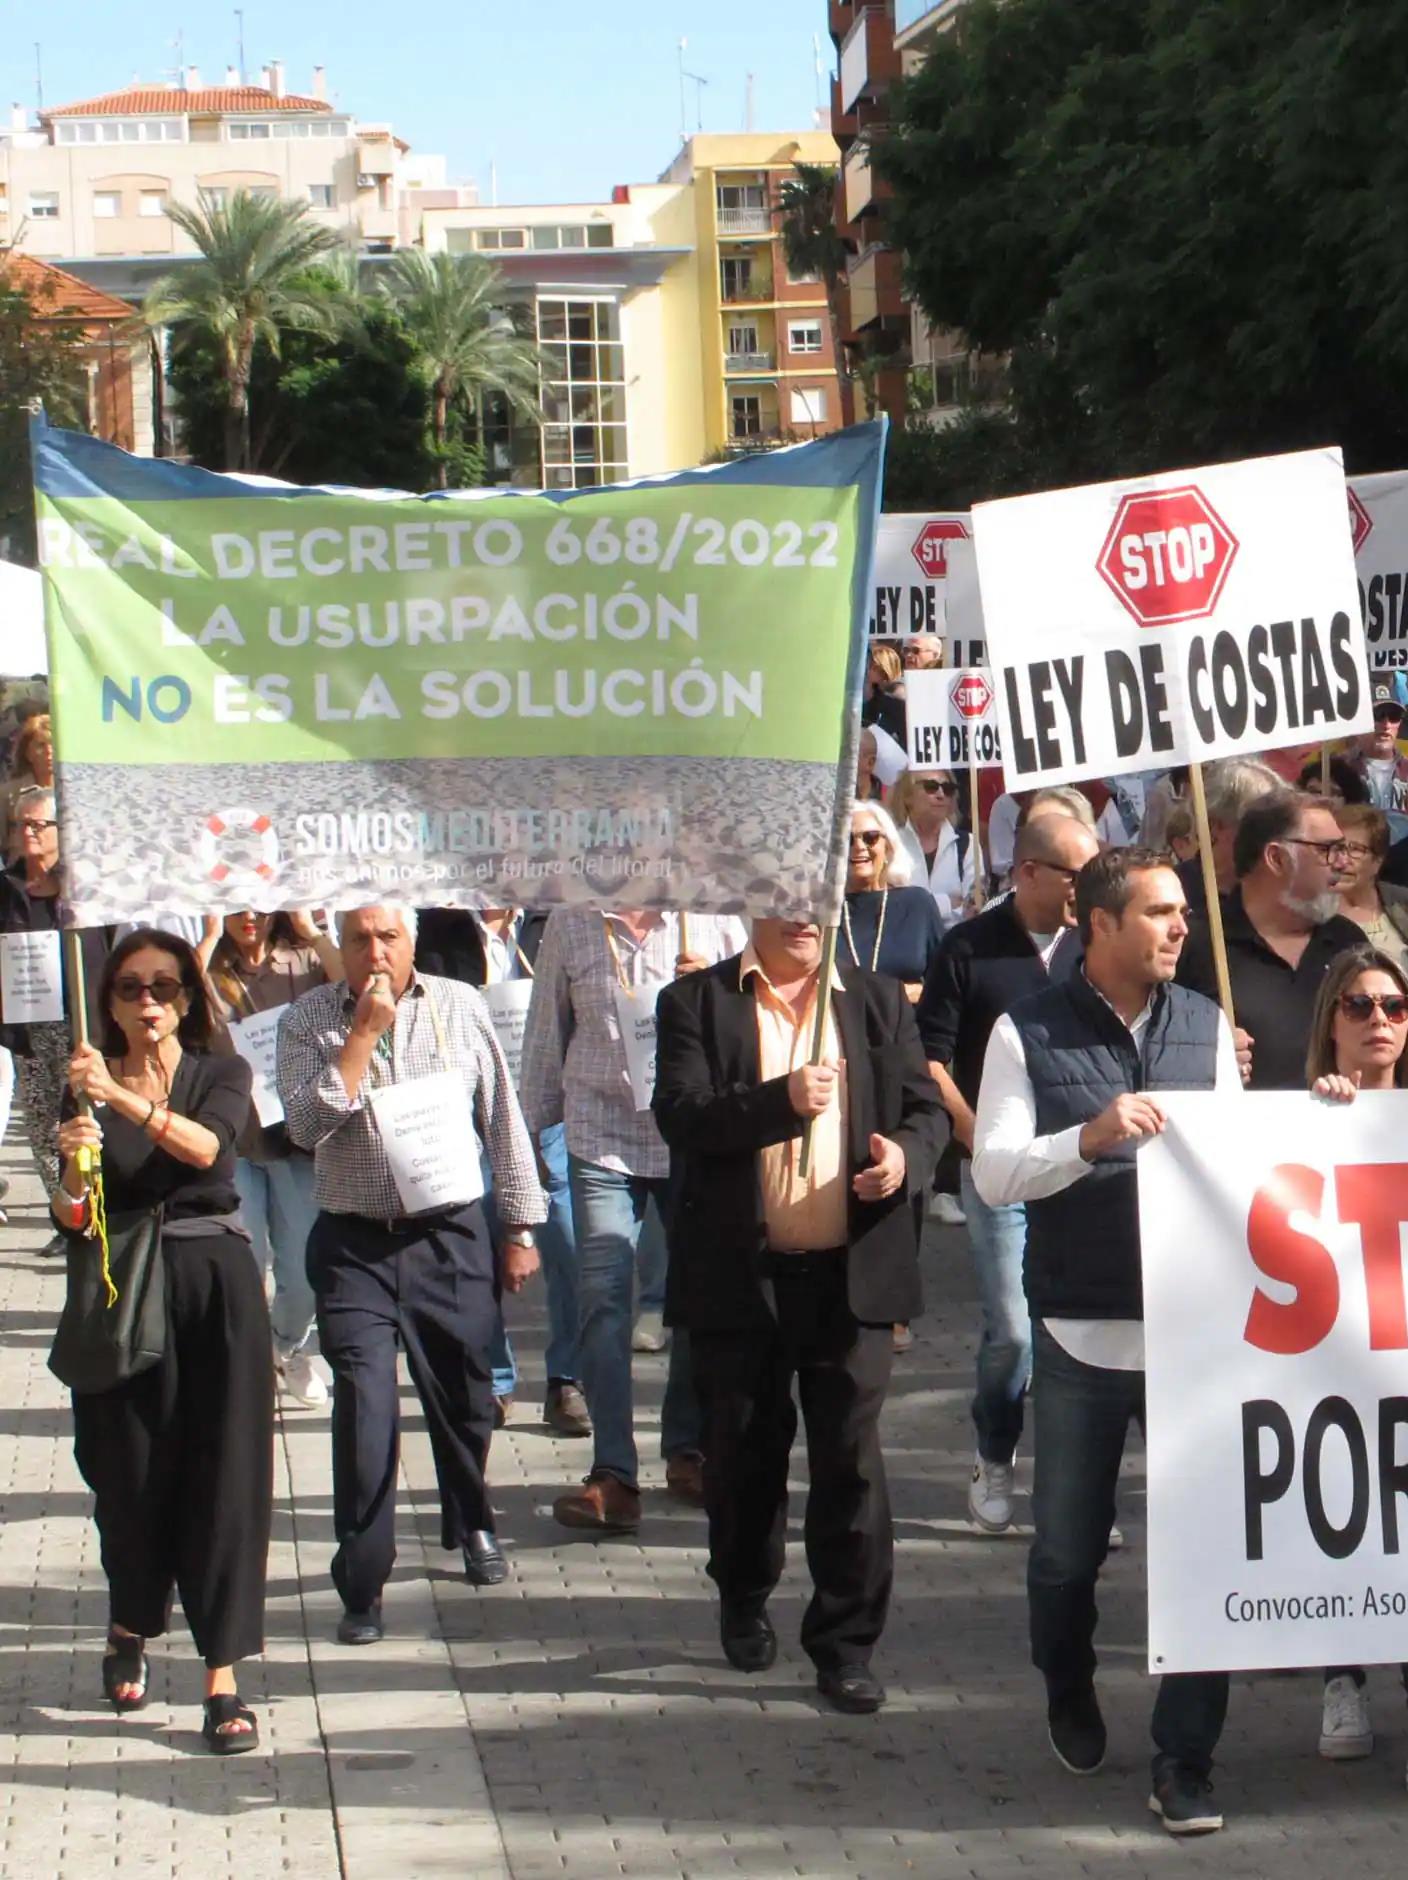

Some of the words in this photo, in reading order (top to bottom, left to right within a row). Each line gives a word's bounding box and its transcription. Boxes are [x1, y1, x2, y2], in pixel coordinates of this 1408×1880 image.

[39, 517, 198, 579] REAL
[211, 517, 523, 580] DECRETO
[545, 512, 839, 572] 668/2022
[922, 537, 947, 562] ST
[1120, 522, 1216, 590] STOP
[161, 597, 245, 648] LA
[268, 580, 700, 648] USURPACIÓN
[909, 585, 936, 633] DE
[102, 674, 192, 724] NO
[213, 673, 292, 724] ES
[315, 672, 401, 722] LA
[421, 656, 763, 722] SOLUCIÓN
[1003, 655, 1087, 774] LEY
[1104, 643, 1175, 758] DE
[1188, 611, 1360, 744] COSTAS
[914, 726, 942, 763] LEY
[1225, 1591, 1353, 1622] Convocan:
